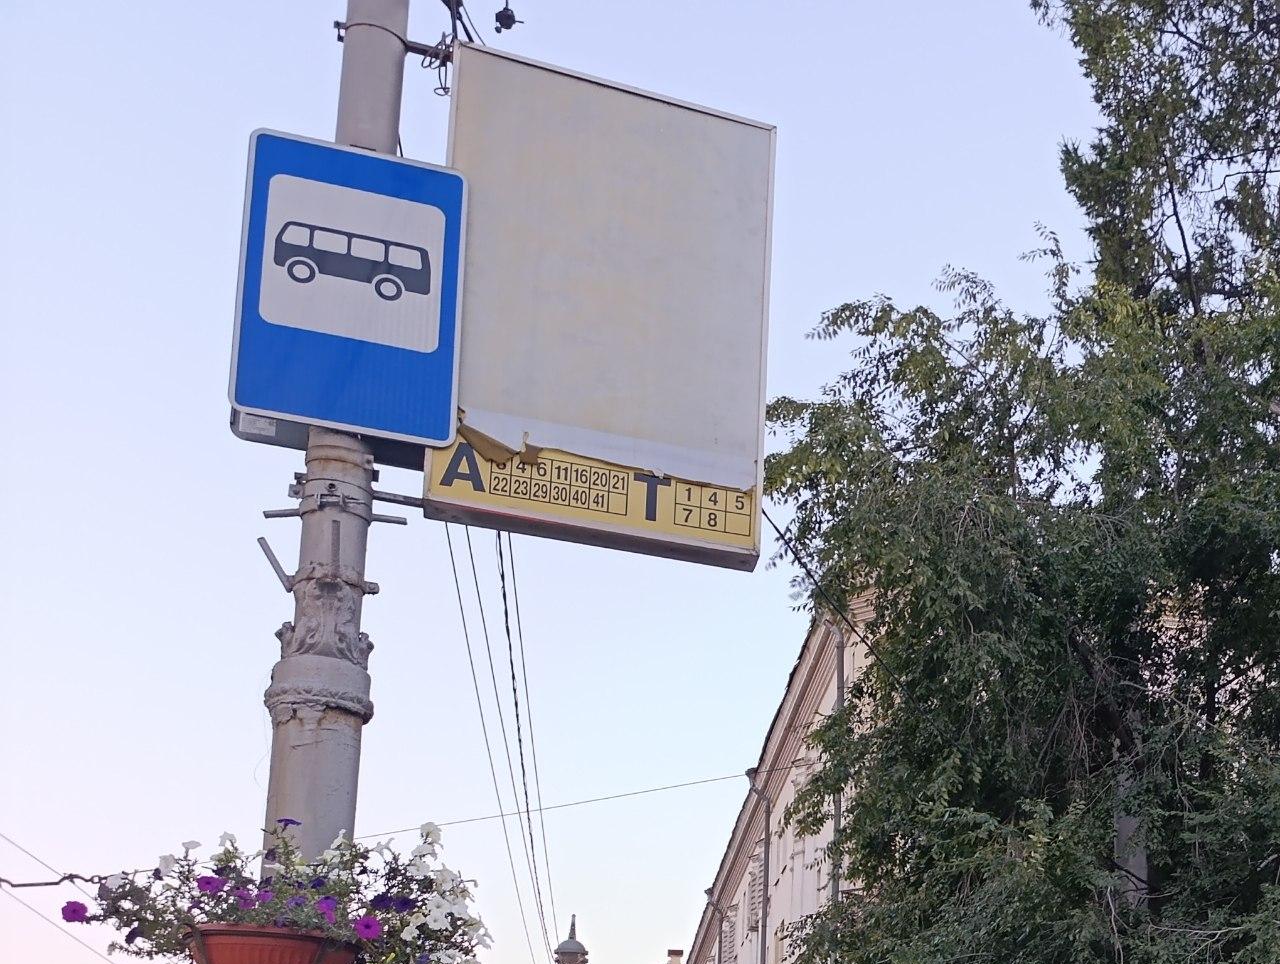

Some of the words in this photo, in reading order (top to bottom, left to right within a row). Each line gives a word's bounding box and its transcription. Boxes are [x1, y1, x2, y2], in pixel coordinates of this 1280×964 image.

[537, 461, 547, 477] 6
[554, 465, 569, 482] 11
[574, 468, 589, 484] 16
[592, 471, 608, 488] 20
[612, 474, 626, 491] 21
[493, 476, 508, 493] 22
[513, 480, 529, 496] 23
[533, 482, 548, 499] 29
[553, 485, 568, 502] 30
[572, 490, 588, 506] 40
[592, 493, 605, 509] 41
[685, 487, 692, 502] 1
[708, 491, 719, 506] 4
[735, 495, 745, 510] 5
[683, 508, 693, 523] 7
[707, 512, 718, 527] 8
